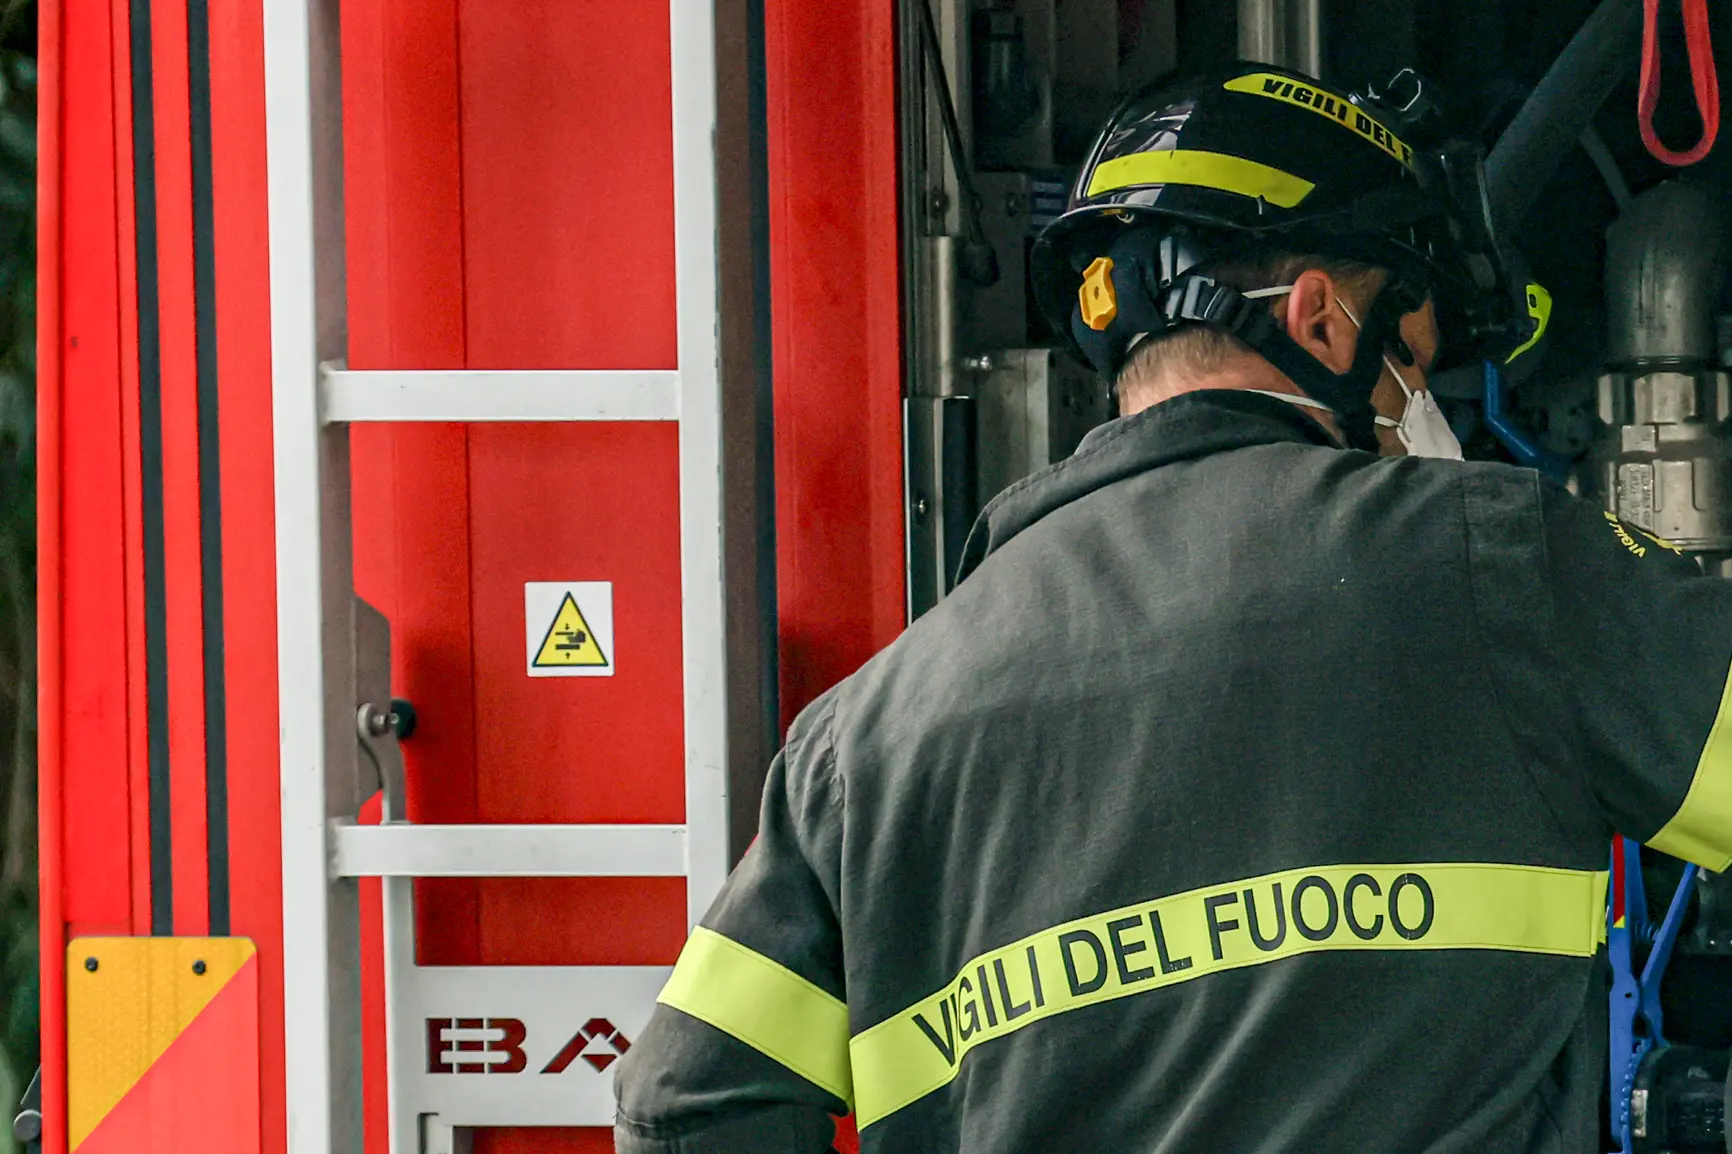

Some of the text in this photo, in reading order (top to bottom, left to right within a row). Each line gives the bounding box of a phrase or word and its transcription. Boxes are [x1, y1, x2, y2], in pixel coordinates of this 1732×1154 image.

[1262, 78, 1348, 121] VIGILI
[1355, 113, 1397, 154] DEL
[912, 872, 1435, 1068] VIGILI DEL FUOCO
